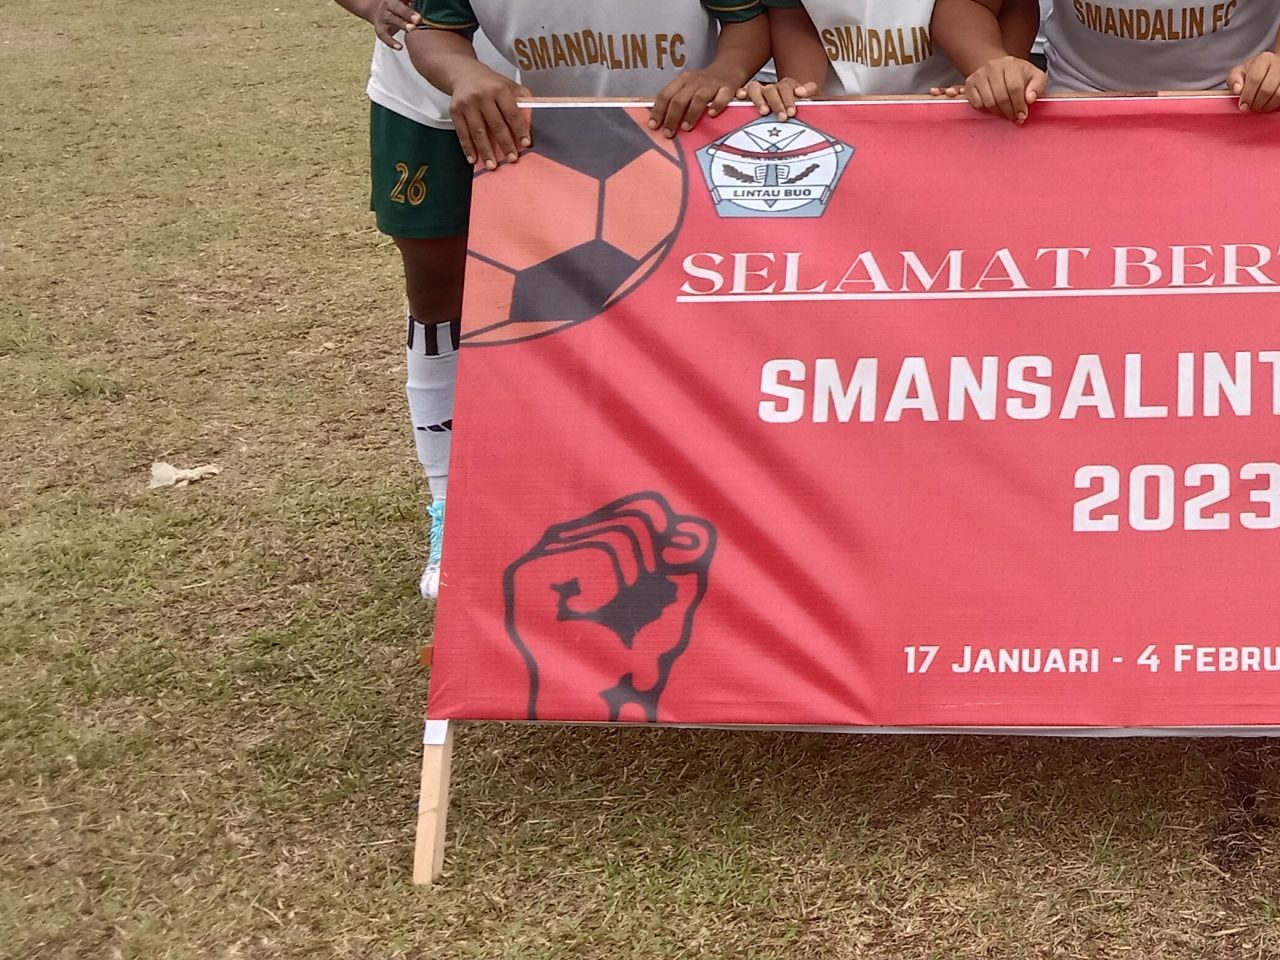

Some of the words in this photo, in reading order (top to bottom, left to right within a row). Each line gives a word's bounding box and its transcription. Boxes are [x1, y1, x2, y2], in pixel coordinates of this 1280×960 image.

[1212, 0, 1237, 33] FC
[655, 33, 686, 69] FC
[390, 162, 428, 206] 26
[733, 189, 780, 198] LINTAU
[784, 188, 812, 197] BUO
[680, 247, 1090, 295] SELAMAT
[903, 645, 939, 673] 17
[1136, 644, 1160, 672] 4
